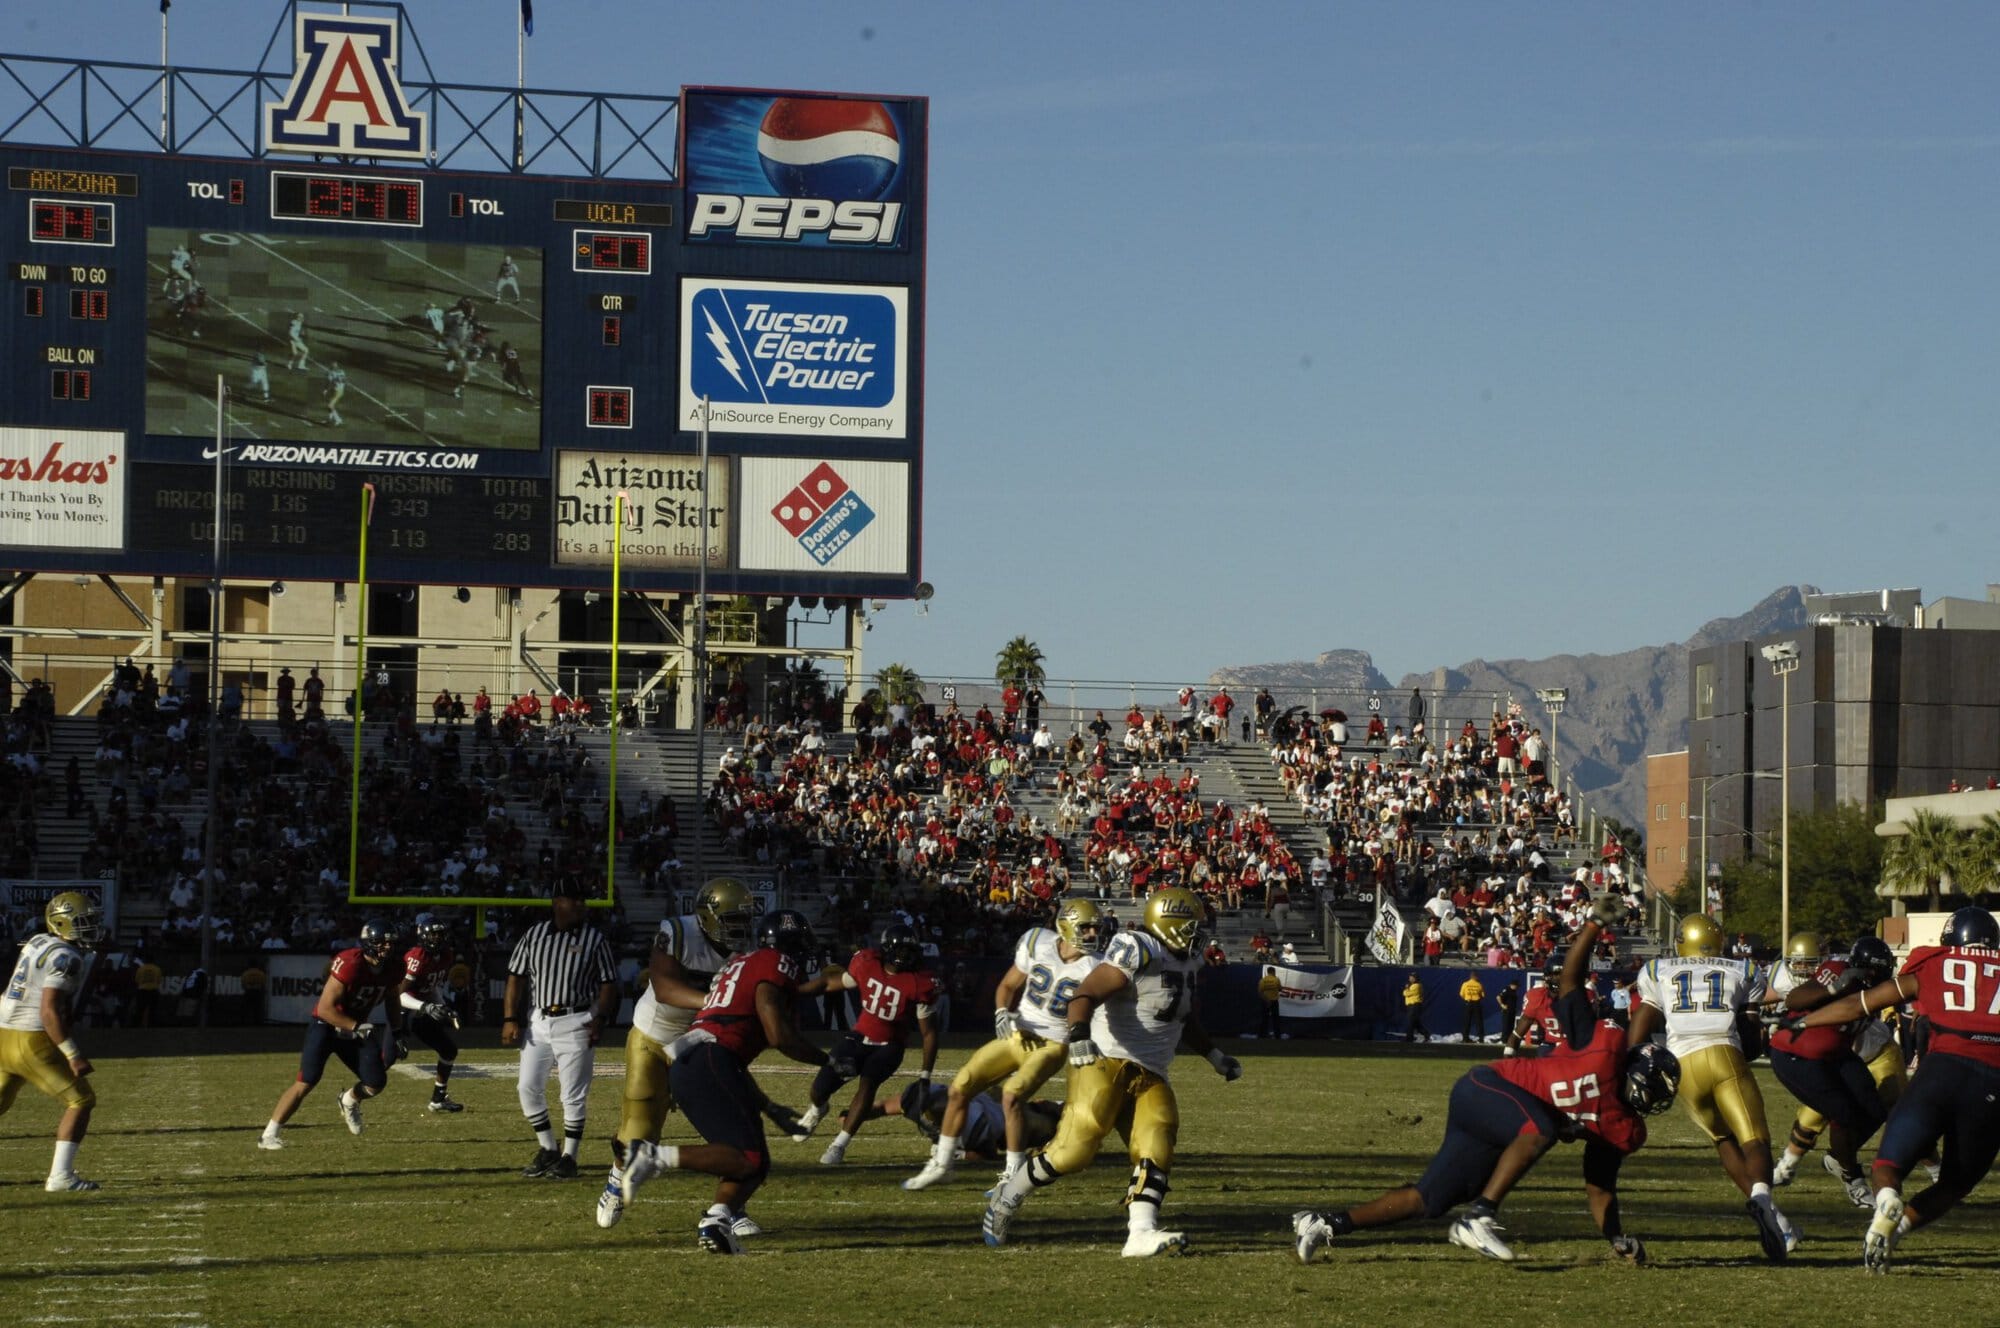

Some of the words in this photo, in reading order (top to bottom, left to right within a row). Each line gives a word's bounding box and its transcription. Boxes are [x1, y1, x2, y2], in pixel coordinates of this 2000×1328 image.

[265, 12, 427, 160] A
[29, 171, 118, 194] ARIZONA
[187, 182, 225, 200] TOL
[309, 179, 419, 221] 2:47
[468, 199, 504, 216] TOL
[587, 203, 636, 223] UCLA
[34, 204, 94, 239] 34
[689, 193, 901, 244] PEPSI
[593, 236, 648, 269] 27
[20, 264, 47, 281] DWN
[71, 267, 87, 282] TO
[89, 268, 107, 284] GO
[80, 289, 108, 319] 10
[602, 294, 623, 311] QTR
[603, 318, 619, 345] 4
[743, 303, 849, 335] Tucson
[48, 347, 75, 364] BALL
[78, 349, 95, 365] ON
[753, 332, 877, 364] Electric
[765, 361, 875, 391] Power
[591, 391, 629, 424] 03
[689, 409, 700, 420] A
[778, 411, 825, 428] Energy
[829, 413, 894, 430] Company
[239, 444, 479, 470] ARIZONAATHLETICS.COM
[247, 468, 336, 491] RUSHING
[368, 473, 454, 497] PASSING
[481, 477, 544, 499] TOTAL
[575, 456, 706, 491] Arizona
[9, 490, 57, 504] Thanks
[59, 492, 85, 506] You
[87, 494, 104, 508] By
[155, 489, 245, 511] ARIZONA
[270, 493, 308, 513] 136
[390, 499, 429, 518] 343
[493, 503, 532, 521] 479
[35, 509, 60, 522] You
[63, 510, 109, 525] Money.
[652, 496, 726, 529] Star
[801, 498, 859, 551] Domino's
[492, 532, 531, 551] 283
[557, 538, 583, 554] It's
[588, 543, 600, 554] a
[813, 529, 852, 563] Pizza
[376, 672, 389, 686] 28
[944, 686, 955, 699] 29
[1368, 697, 1381, 711] 30
[99, 868, 115, 880] 28
[759, 880, 774, 890] 29
[14, 888, 101, 904] BRUEGR'S
[1358, 892, 1374, 903] 30
[1108, 940, 1135, 969] 71
[862, 976, 901, 1022] 33
[1028, 963, 1081, 1019] 26
[1279, 987, 1315, 1001] SPN
[1671, 970, 1729, 1013] 11
[1943, 958, 2000, 1015] 97
